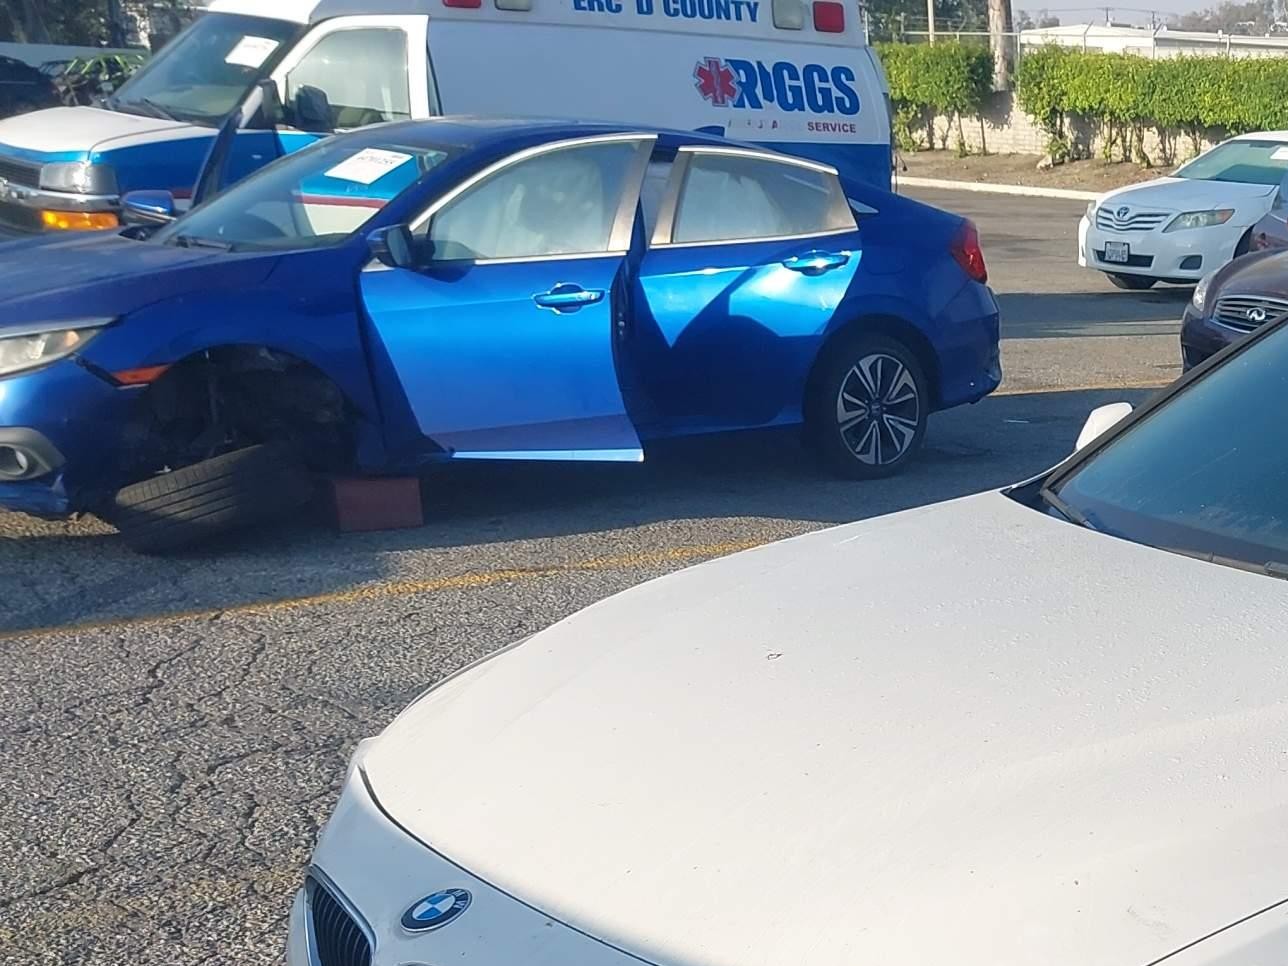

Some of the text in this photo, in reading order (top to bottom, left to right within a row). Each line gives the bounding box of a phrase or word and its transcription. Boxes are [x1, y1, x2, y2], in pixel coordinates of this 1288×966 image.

[663, 0, 760, 23] COUNTY
[725, 58, 861, 116] RIGGS
[807, 121, 857, 133] SERVICE
